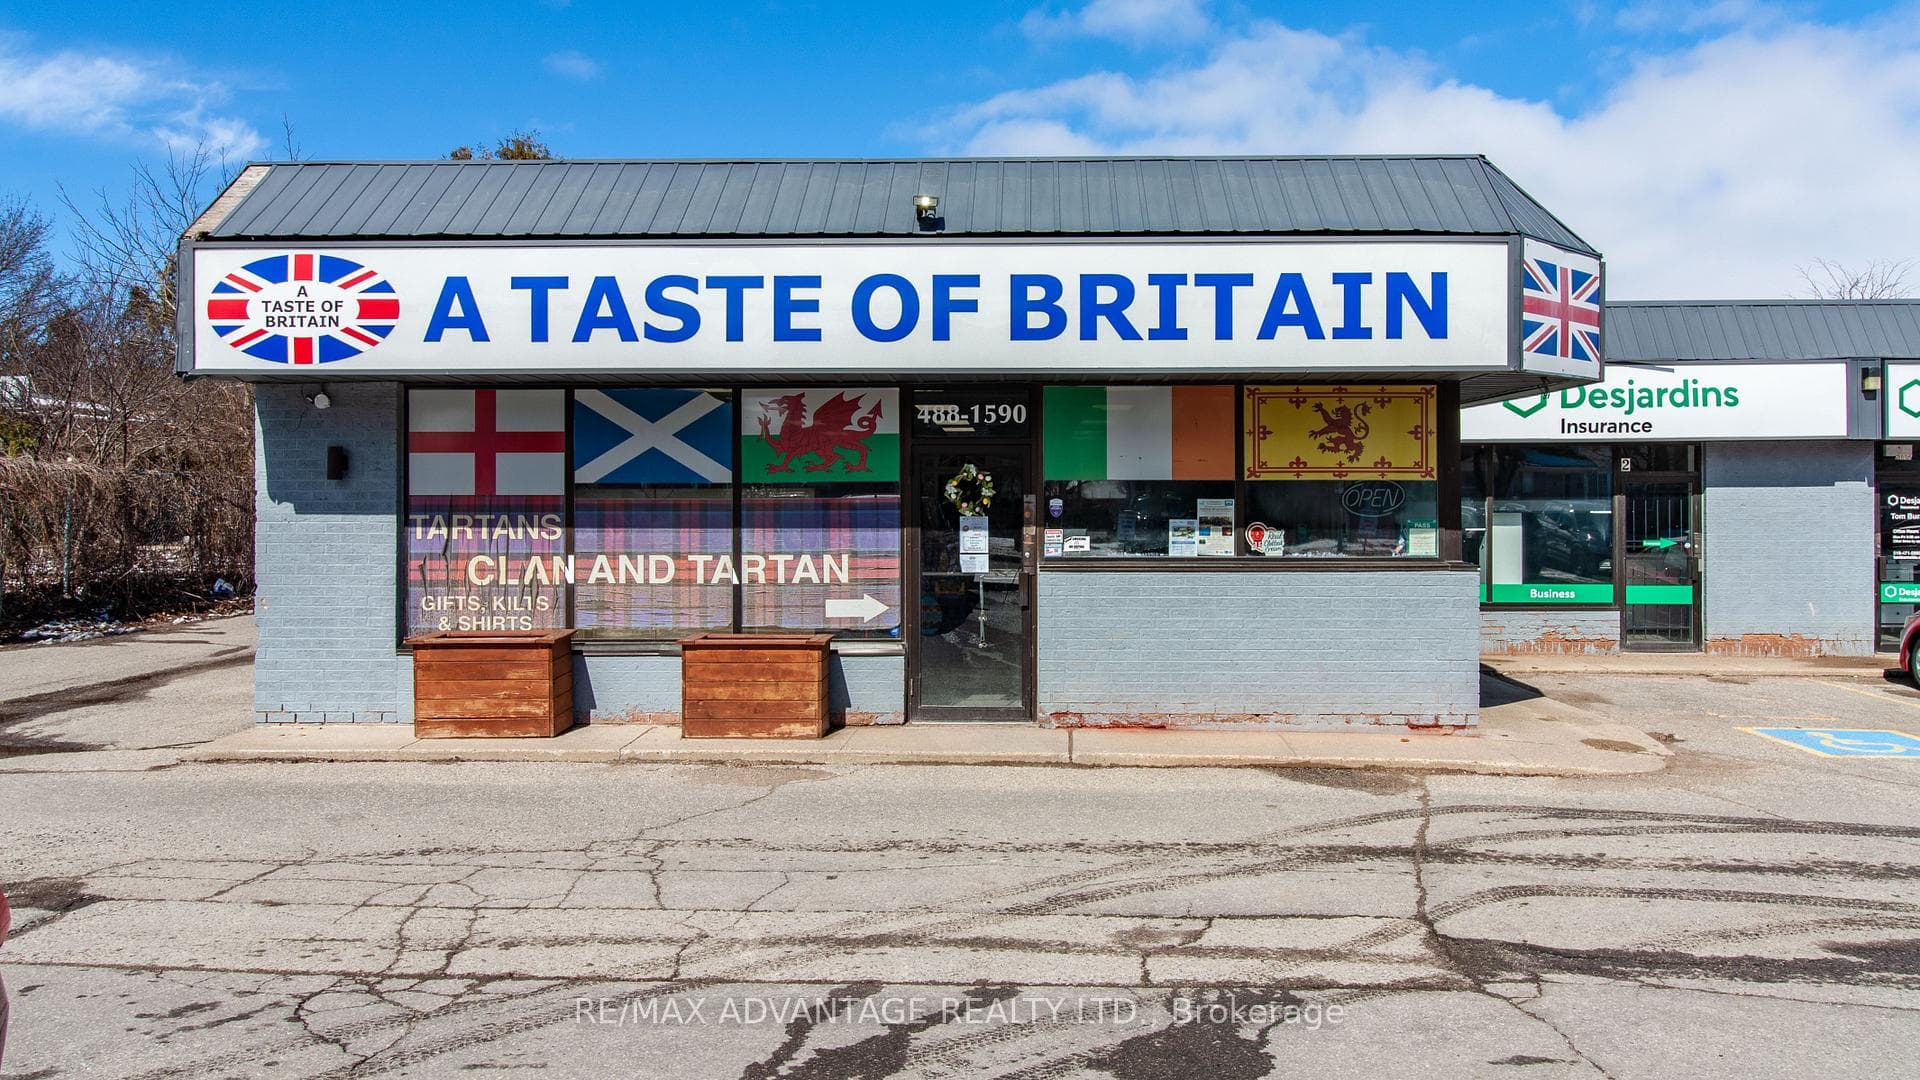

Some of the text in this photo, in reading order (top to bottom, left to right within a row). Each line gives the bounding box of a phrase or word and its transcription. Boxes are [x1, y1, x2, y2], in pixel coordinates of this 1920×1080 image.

[296, 285, 308, 298] A
[261, 300, 344, 313] TASTE OF
[423, 272, 1449, 344] A TASTE OF BRITAIN
[265, 315, 340, 328] BRITAIN
[1560, 379, 1739, 415] Desjardins
[917, 404, 1027, 424] 488-1590
[1560, 418, 1653, 434] Insurance
[1622, 459, 1630, 471] 2
[1345, 488, 1399, 507] OPEN
[409, 514, 562, 541] TARTANS
[468, 554, 849, 585] CLAN AND TARTAN
[1530, 588, 1575, 599] Business
[421, 596, 550, 613] GIFTS, KILTS
[438, 615, 532, 631] & SHIRTS
